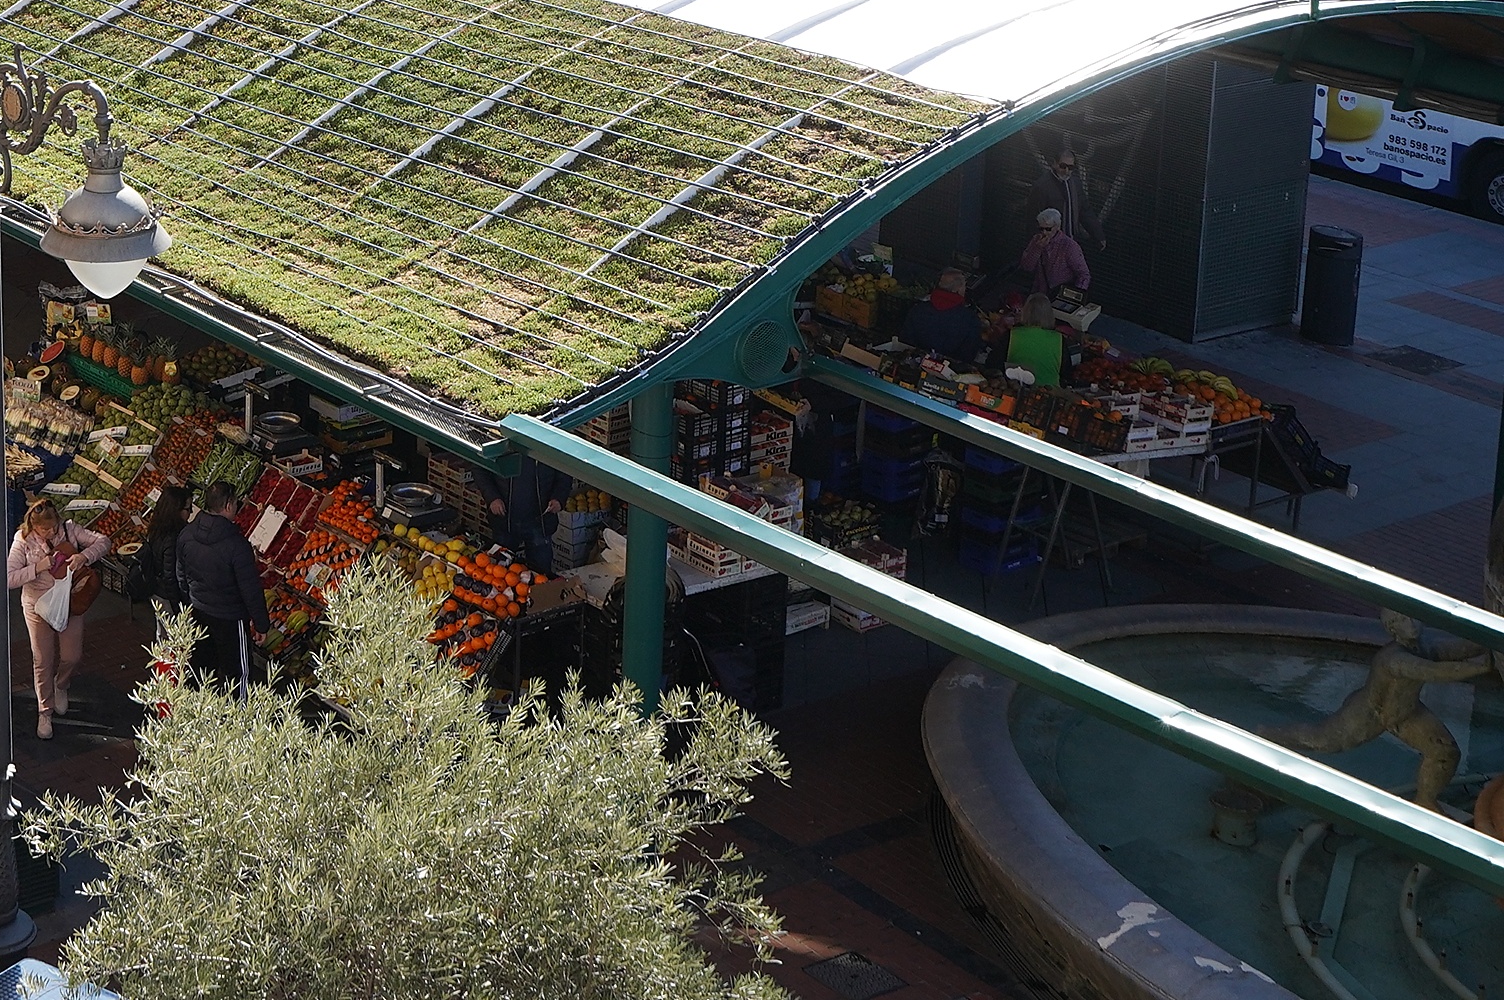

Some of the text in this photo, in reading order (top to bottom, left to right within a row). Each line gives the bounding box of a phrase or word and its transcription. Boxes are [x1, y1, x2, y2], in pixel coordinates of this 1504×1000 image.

[1388, 134, 1447, 156] 983 598 172
[1366, 148, 1387, 160] Teresa
[1384, 142, 1446, 166] banospacio.es
[766, 430, 787, 442] Kira
[766, 445, 786, 456] Kira
[552, 543, 570, 554] erlim
[552, 558, 570, 570] erlim
